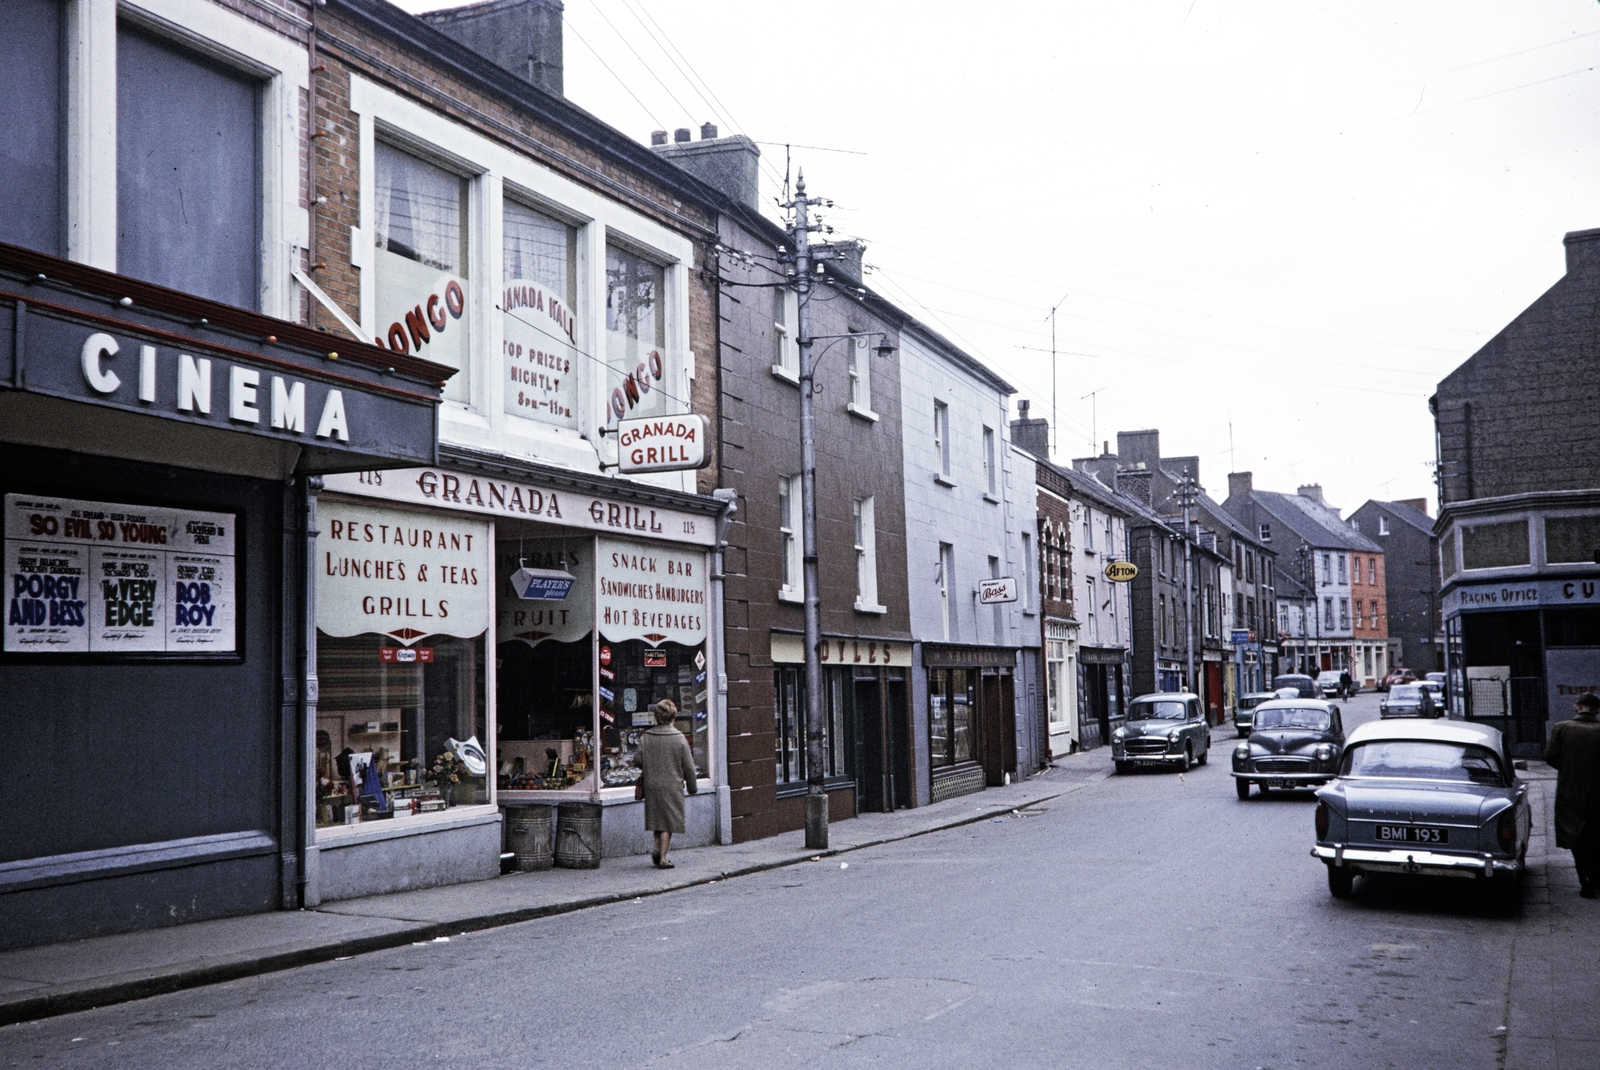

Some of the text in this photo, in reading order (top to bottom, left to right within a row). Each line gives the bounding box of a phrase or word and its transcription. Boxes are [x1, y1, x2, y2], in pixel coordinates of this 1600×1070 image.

[375, 279, 464, 355] ONGO
[549, 296, 576, 346] HALL
[503, 339, 570, 374] TOP PRIZES
[81, 333, 350, 442] CINEMA
[620, 422, 696, 447] GRANADA
[631, 445, 689, 465] GRILL
[415, 470, 563, 518] GRANADA
[588, 500, 662, 533] GRILL
[29, 513, 59, 536] SO
[97, 520, 116, 541] SO
[119, 522, 167, 545] YOUNG
[331, 519, 474, 552] RESTAURANT
[326, 551, 478, 586] LUNCHES & TEAS
[612, 552, 692, 577] SNACK BAR
[1107, 563, 1136, 577] AFTON
[13, 574, 80, 600] PORGY
[118, 578, 158, 601] VERY
[176, 581, 211, 605] ROB
[530, 579, 571, 591] PLAYER'S
[544, 590, 566, 598] please
[601, 576, 704, 605] SANDWICHES HAMBURGERS
[982, 584, 1006, 601] Bass
[1461, 591, 1497, 604] RACING
[1502, 588, 1538, 602] OFFICE
[9, 598, 85, 627] AND BESS
[105, 600, 154, 627] EDGE
[176, 603, 216, 627] ROY
[362, 595, 449, 618] GRILLS
[604, 606, 701, 631] HOT BEVERAGES
[803, 638, 891, 664] OYLES
[1381, 826, 1440, 842] BMI 193
